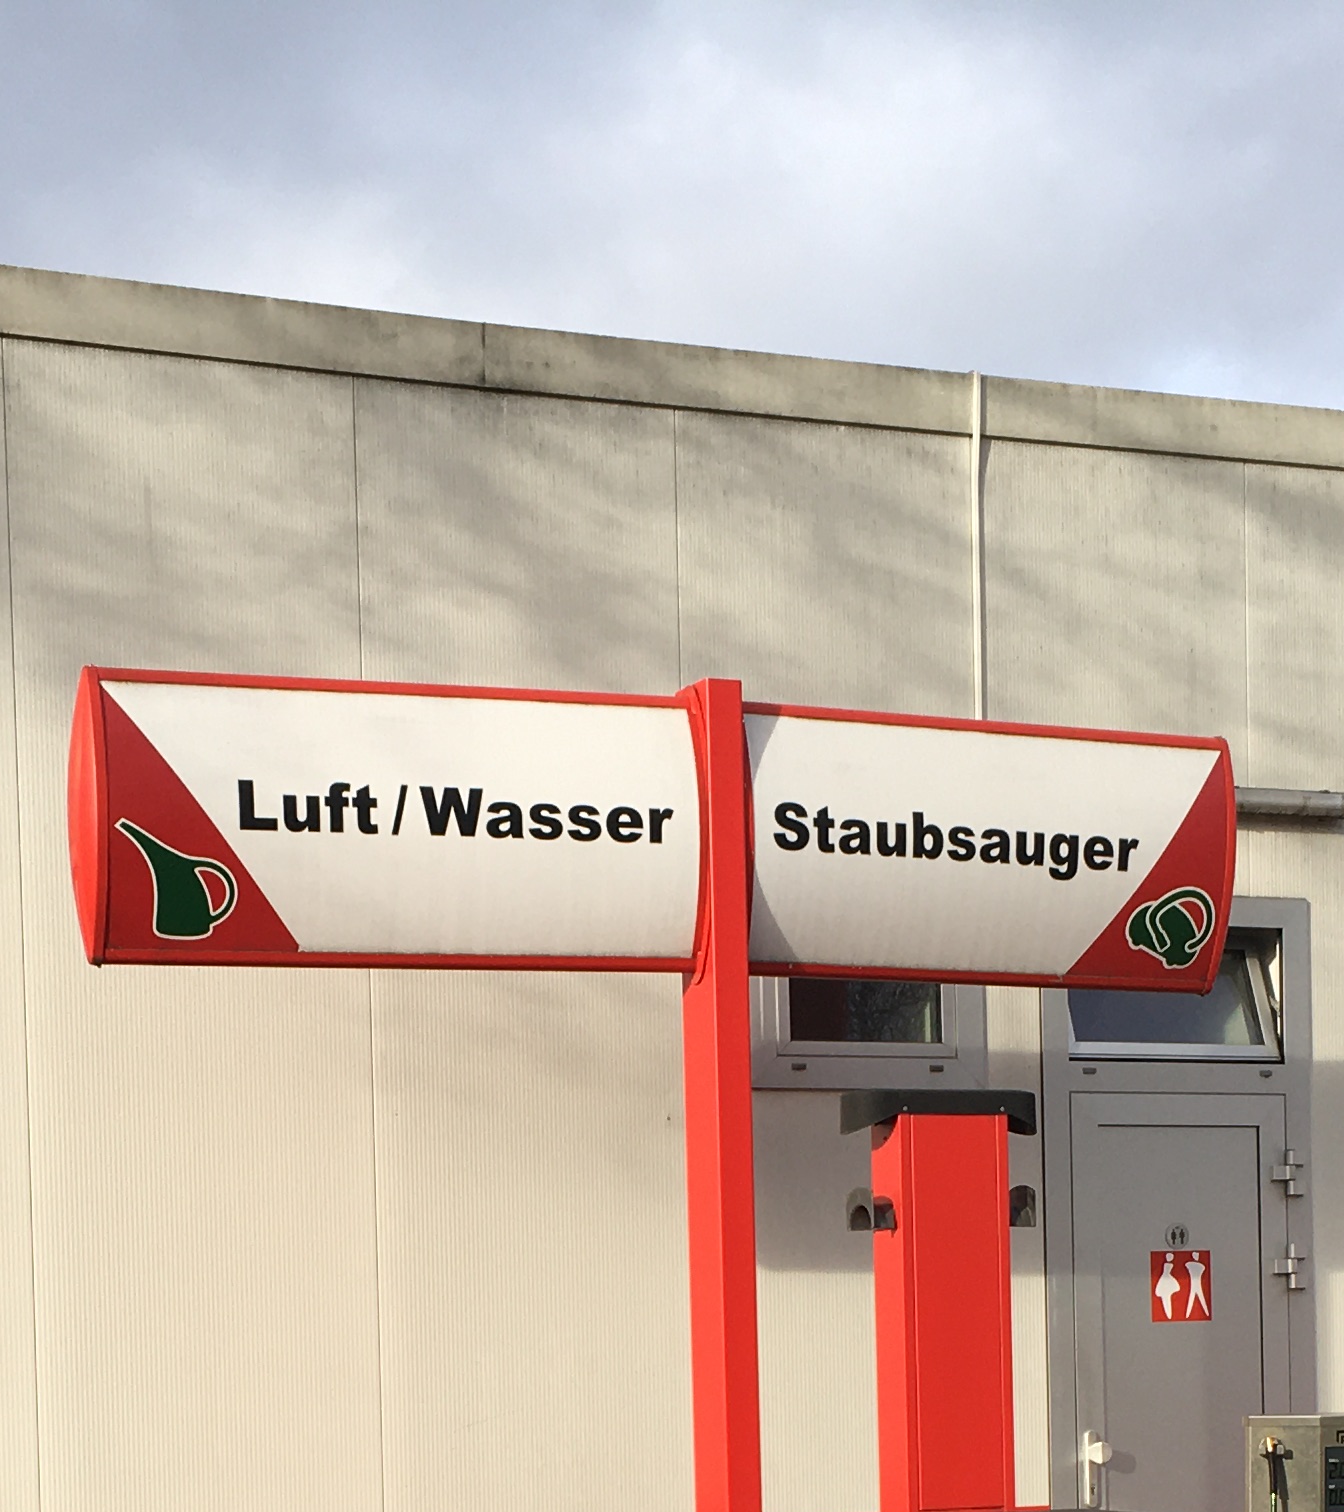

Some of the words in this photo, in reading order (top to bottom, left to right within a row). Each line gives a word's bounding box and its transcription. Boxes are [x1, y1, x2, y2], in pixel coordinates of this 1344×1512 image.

[238, 779, 379, 835] Luft
[419, 785, 674, 844] Wasser
[773, 802, 1139, 881] Staubsauger
